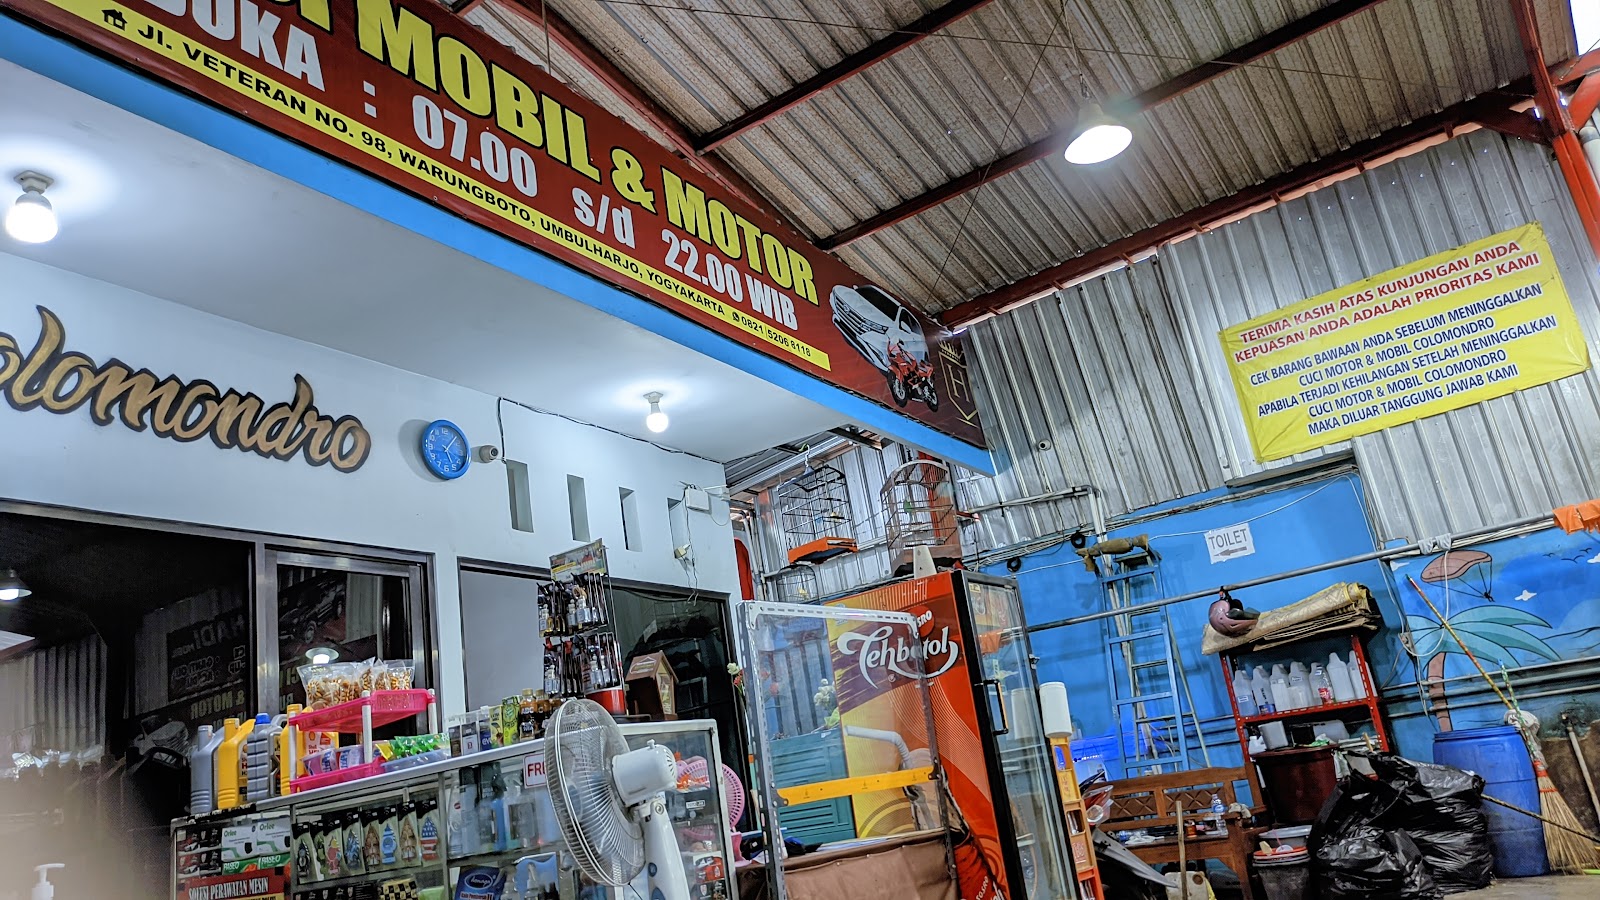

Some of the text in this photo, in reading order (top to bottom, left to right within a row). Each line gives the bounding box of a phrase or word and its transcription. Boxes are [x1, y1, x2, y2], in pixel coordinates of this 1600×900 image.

[145, 0, 326, 92] UKA
[412, 94, 538, 198] 07.00
[662, 228, 744, 304] 22.00
[745, 273, 798, 331] WIB
[182, 41, 306, 115] VETERAN
[315, 106, 354, 138] NO.
[361, 132, 392, 159] 98,
[399, 150, 536, 227] WARUNGBOTO,
[540, 217, 643, 279] UMBULHARJO,
[646, 268, 725, 316] YOGYAKARTA
[741, 316, 764, 335] 0821
[767, 328, 790, 348] 5206
[354, 0, 819, 306] MOBIL & MOTOR
[1235, 253, 1540, 362] KEPUASAN ANDA ADALAH PRIORITAS KAMI
[1241, 242, 1520, 343] TERIMA KASIH ATAS KUNJUNGAN ANDA
[1251, 283, 1542, 386] CEK BARANG BAWAAN ANDA SEBELUM MENINGGALKAN
[1258, 315, 1557, 417] APABILA TERJADI KEHILANGAN SETELAH MENINGGALKAN
[1299, 317, 1494, 386] CUCI MOTOR & MOBIL COLOMONDRO
[1309, 349, 1507, 418] CUCI MOTOR & MOBIL COLOMONDRO
[1308, 364, 1519, 435] MAKA DILUAR TANGGUNG JAWAB KAMI
[1208, 528, 1248, 550] TOILET
[210, 879, 248, 900] PERAWATAN
[249, 876, 269, 895] MESIN
[223, 860, 240, 871] PASEO
[260, 854, 281, 866] PASEO
